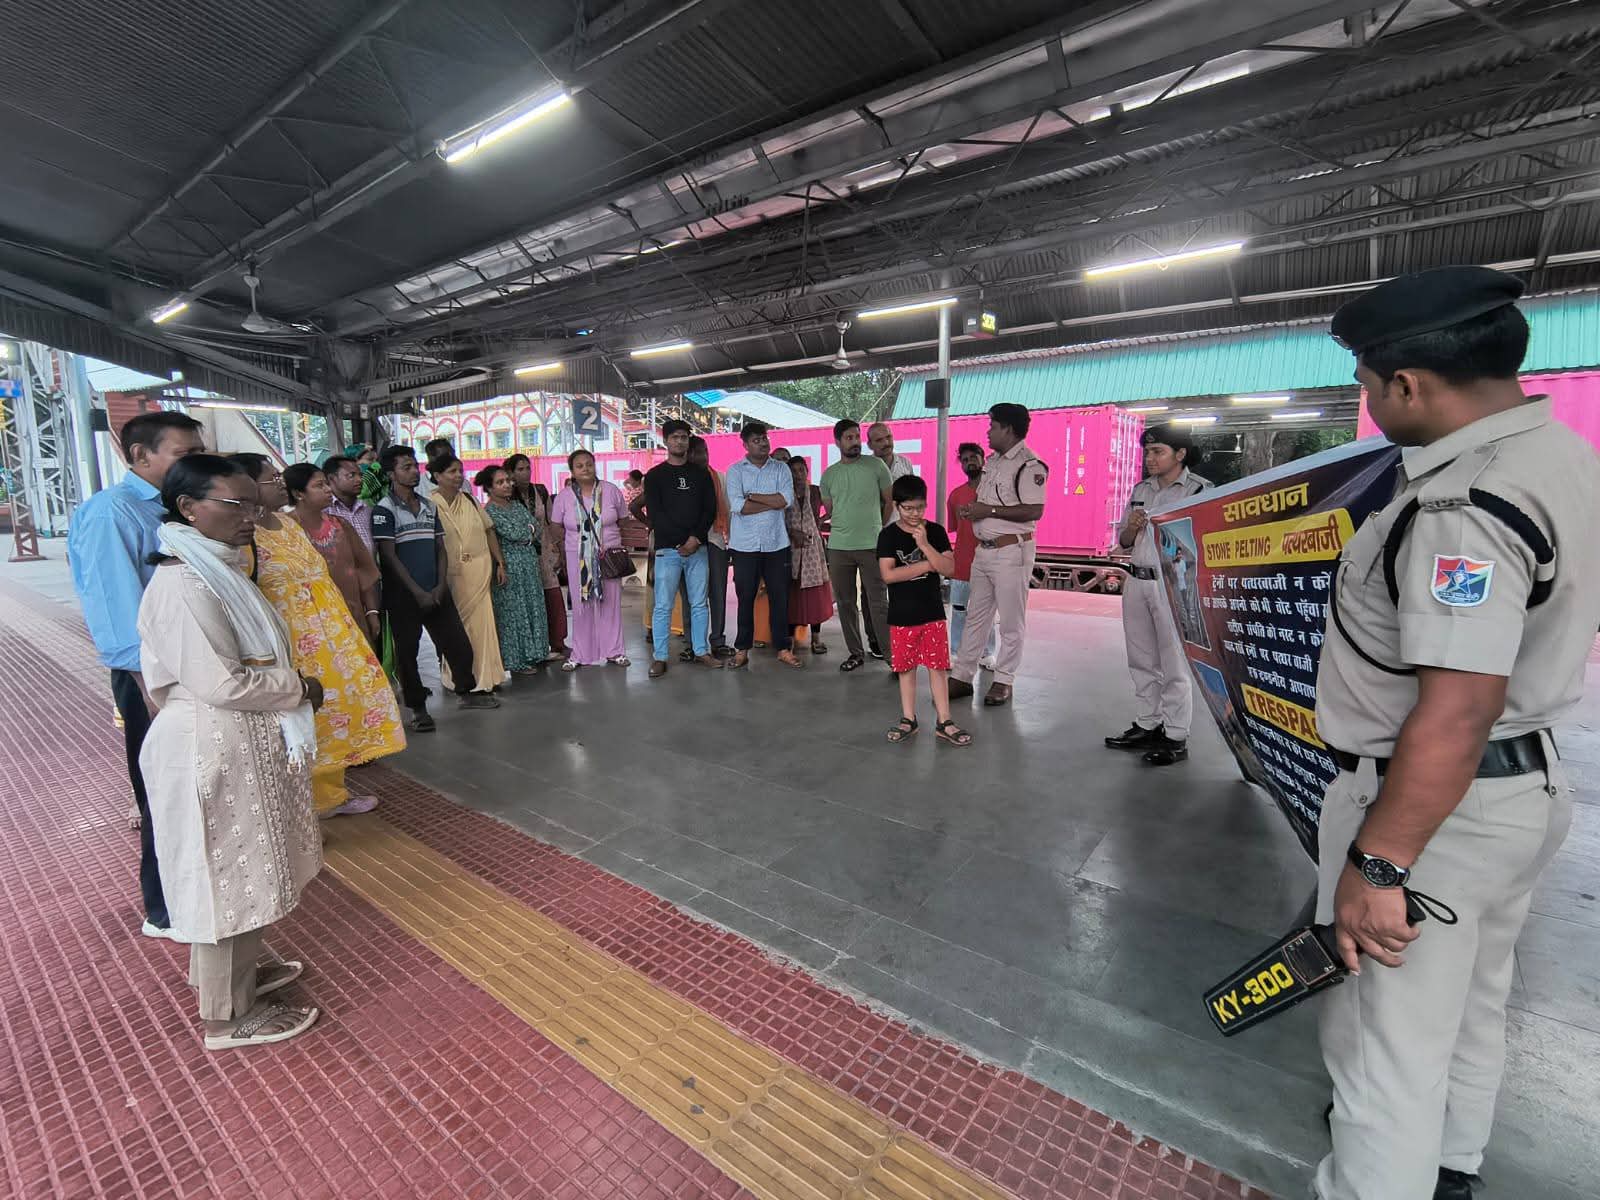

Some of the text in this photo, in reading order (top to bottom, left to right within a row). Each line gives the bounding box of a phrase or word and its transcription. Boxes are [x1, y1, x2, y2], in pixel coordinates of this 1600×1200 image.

[580, 406, 598, 430] 2
[1223, 482, 1309, 522] सावधान
[1207, 539, 1231, 561] STONE
[1235, 535, 1272, 560] PELTING
[1294, 576, 1304, 591] न
[1297, 629, 1306, 645] न
[1213, 962, 1295, 1024] KY-300
